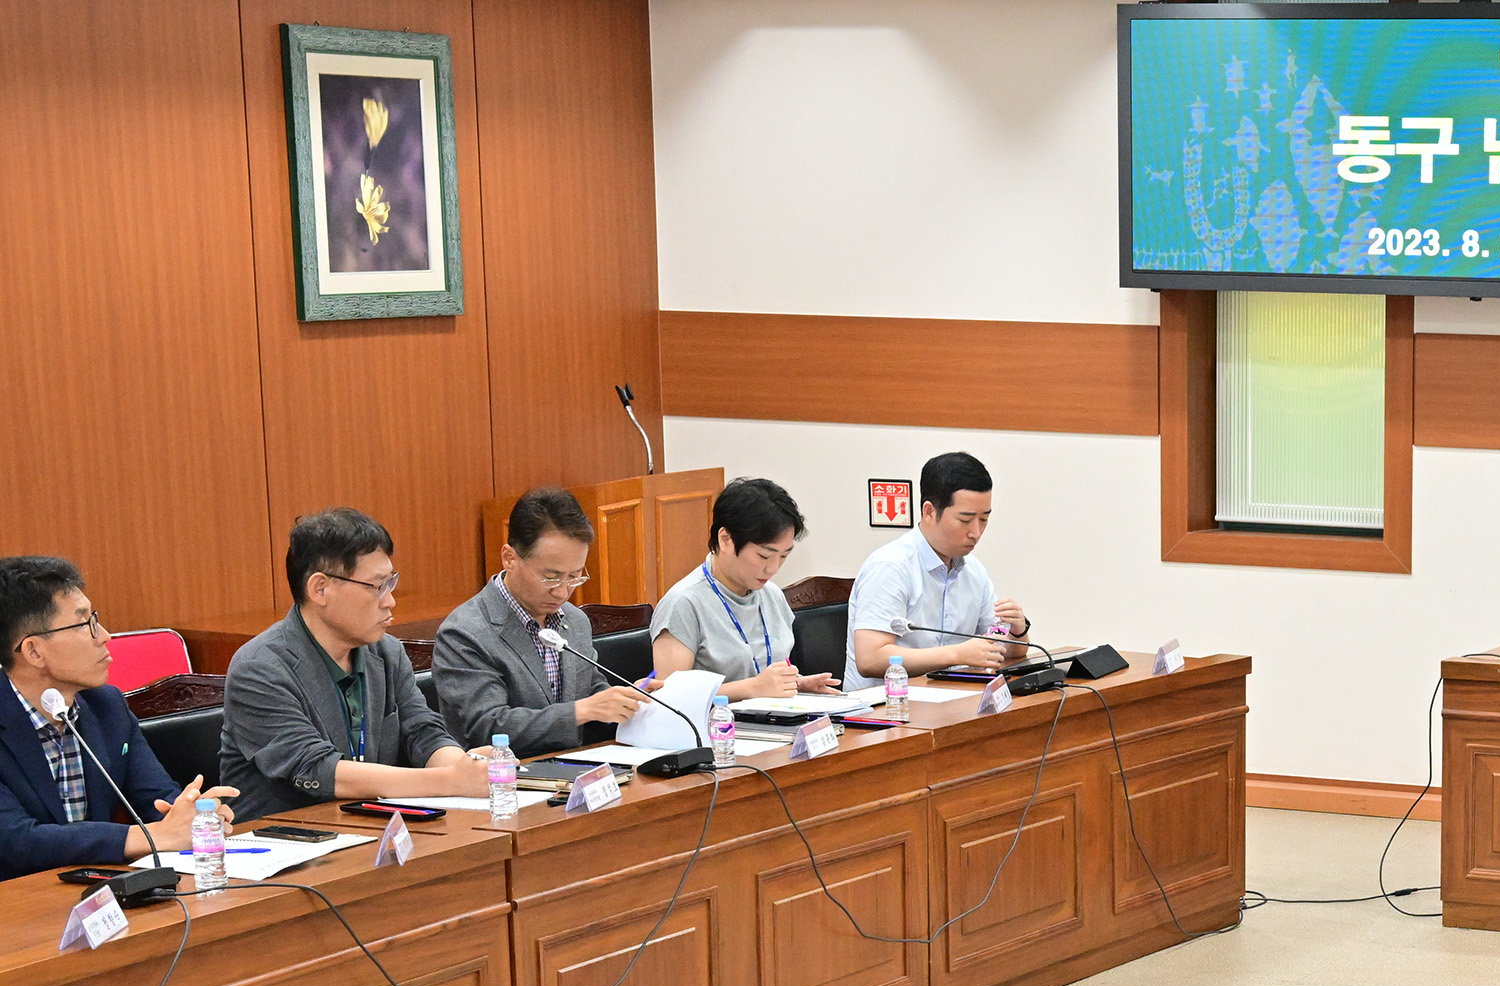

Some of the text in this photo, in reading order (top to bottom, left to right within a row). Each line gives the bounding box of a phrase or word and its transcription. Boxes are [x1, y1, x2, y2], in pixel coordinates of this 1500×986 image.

[1332, 115, 1460, 184] 동구
[1367, 227, 1450, 257] 2023.
[1461, 229, 1490, 258] 8.
[874, 485, 907, 494] 소화기
